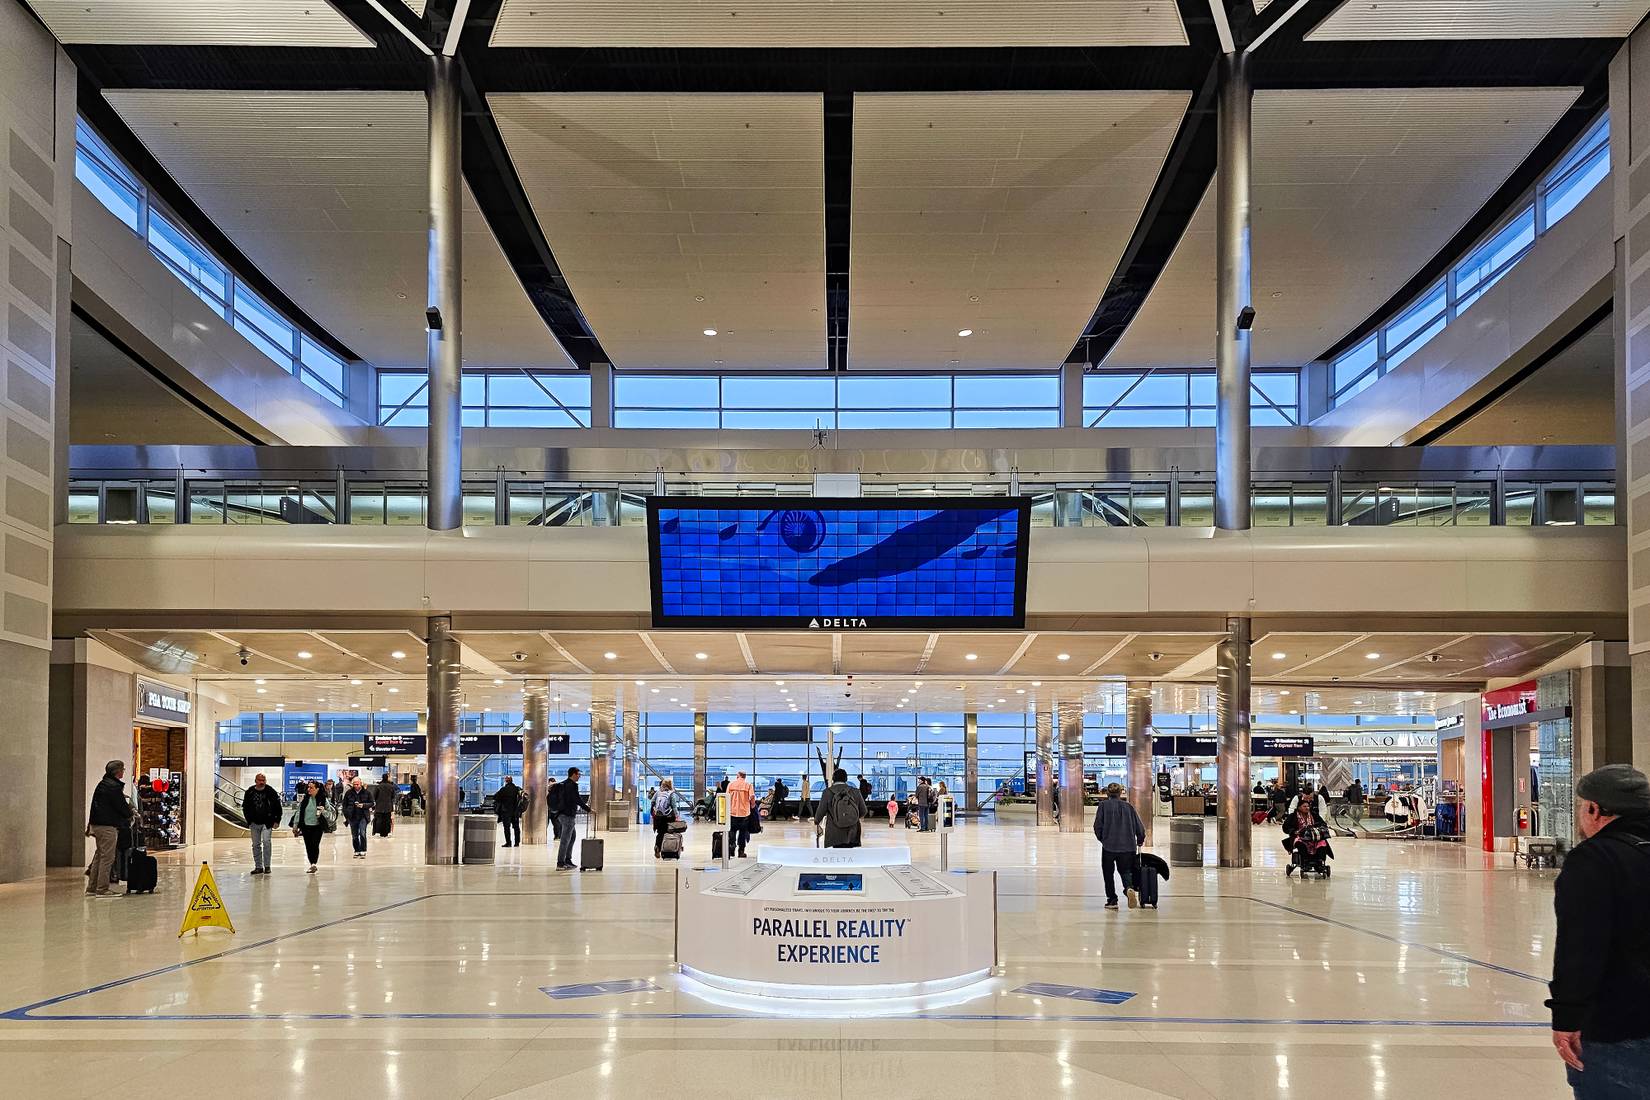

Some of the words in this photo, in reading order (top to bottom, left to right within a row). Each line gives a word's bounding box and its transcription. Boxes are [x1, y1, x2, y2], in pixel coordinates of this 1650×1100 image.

[823, 618, 867, 628] DELTA
[148, 691, 162, 708] PGA
[162, 695, 177, 711] TOUR
[177, 699, 192, 714] SHOP
[1487, 706, 1497, 721] The
[1497, 701, 1527, 719] Economist
[1348, 735, 1394, 747] VINO
[1415, 735, 1438, 747] VO
[822, 856, 854, 864] DELTA
[753, 917, 832, 938] PARALLEL
[778, 944, 880, 964] EXPERIENCE
